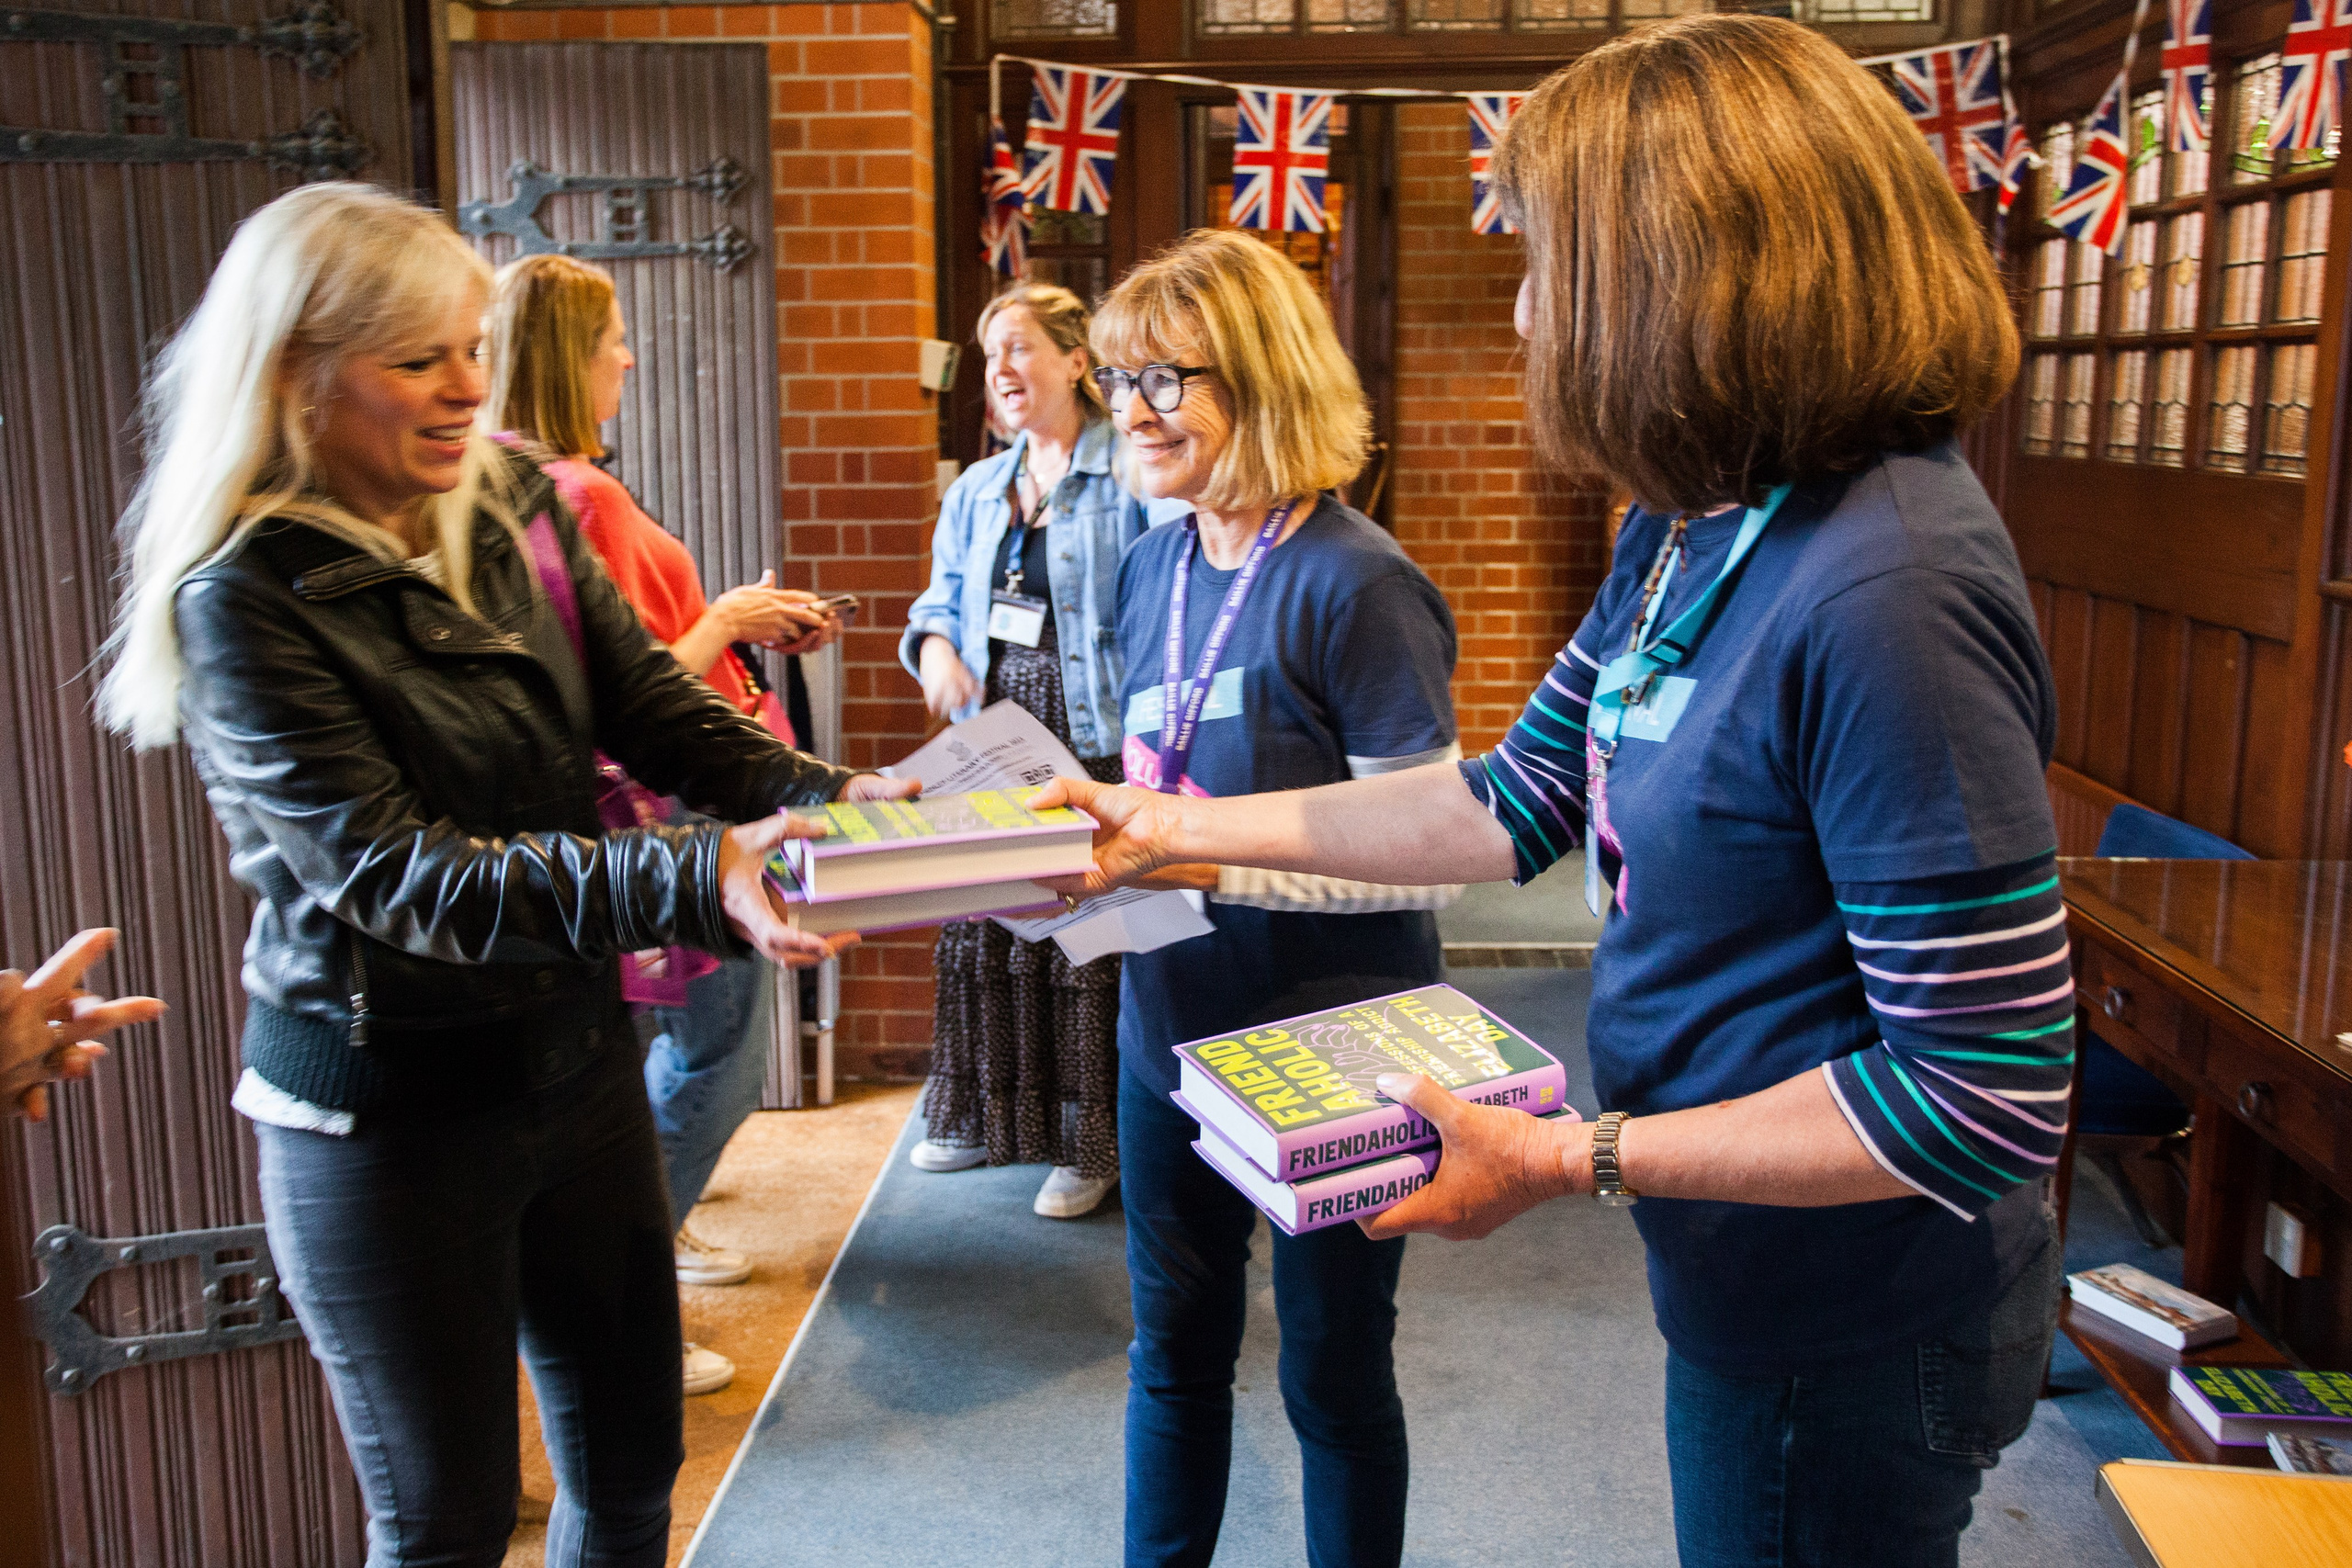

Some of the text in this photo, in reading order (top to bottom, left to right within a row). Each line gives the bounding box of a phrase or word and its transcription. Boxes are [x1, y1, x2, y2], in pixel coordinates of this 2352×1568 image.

[1347, 1020, 1371, 1031] OF
[1354, 1007, 1468, 1087] FRIENDSHIP ADDICT
[1387, 996, 1514, 1079] ELIZABETH
[1447, 1013, 1510, 1043] DAY
[1196, 1040, 1323, 1126] FRIEND
[1244, 1028, 1373, 1111] AHOLIC
[1307, 1171, 1433, 1223] FRIENDAHO
